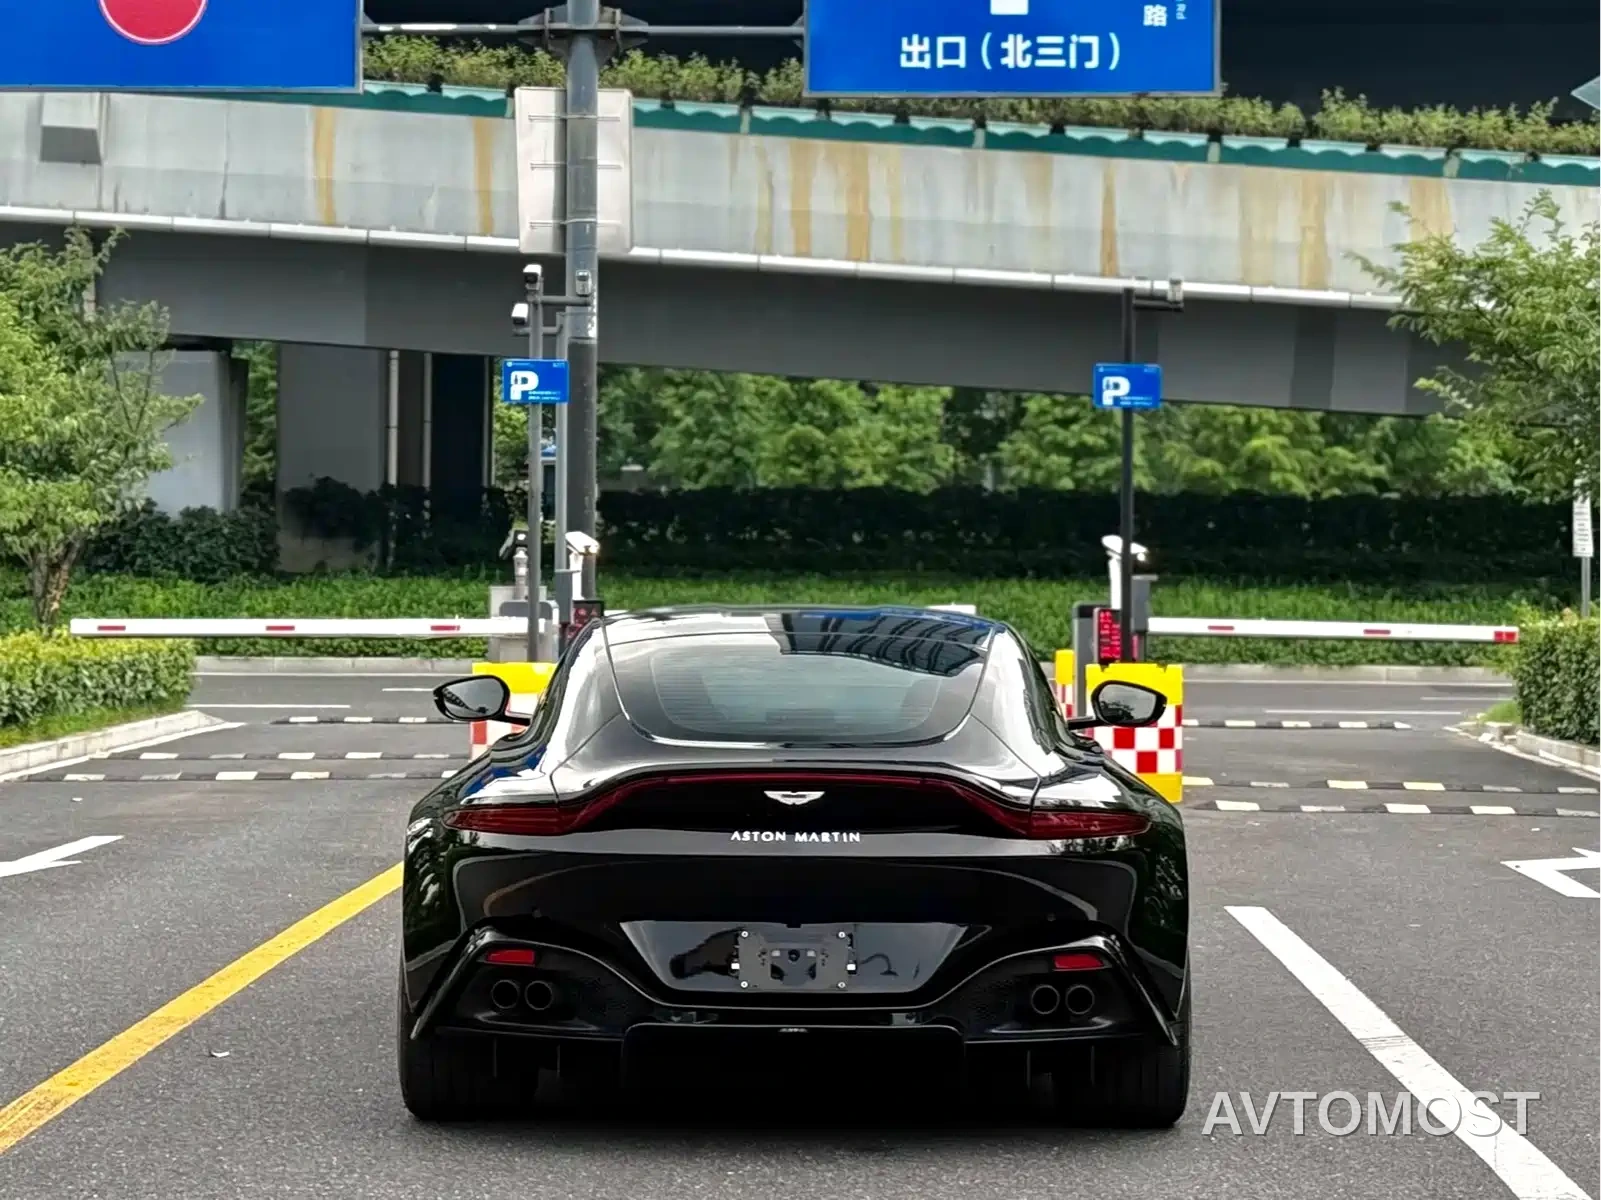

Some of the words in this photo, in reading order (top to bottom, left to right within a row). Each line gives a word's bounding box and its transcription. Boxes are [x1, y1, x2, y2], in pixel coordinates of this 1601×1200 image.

[1143, 4, 1167, 27] 路
[1175, 3, 1188, 21] Rd
[510, 370, 539, 401] P
[1102, 376, 1131, 406] P
[730, 830, 787, 843] ASTON
[794, 831, 861, 843] MARTIN
